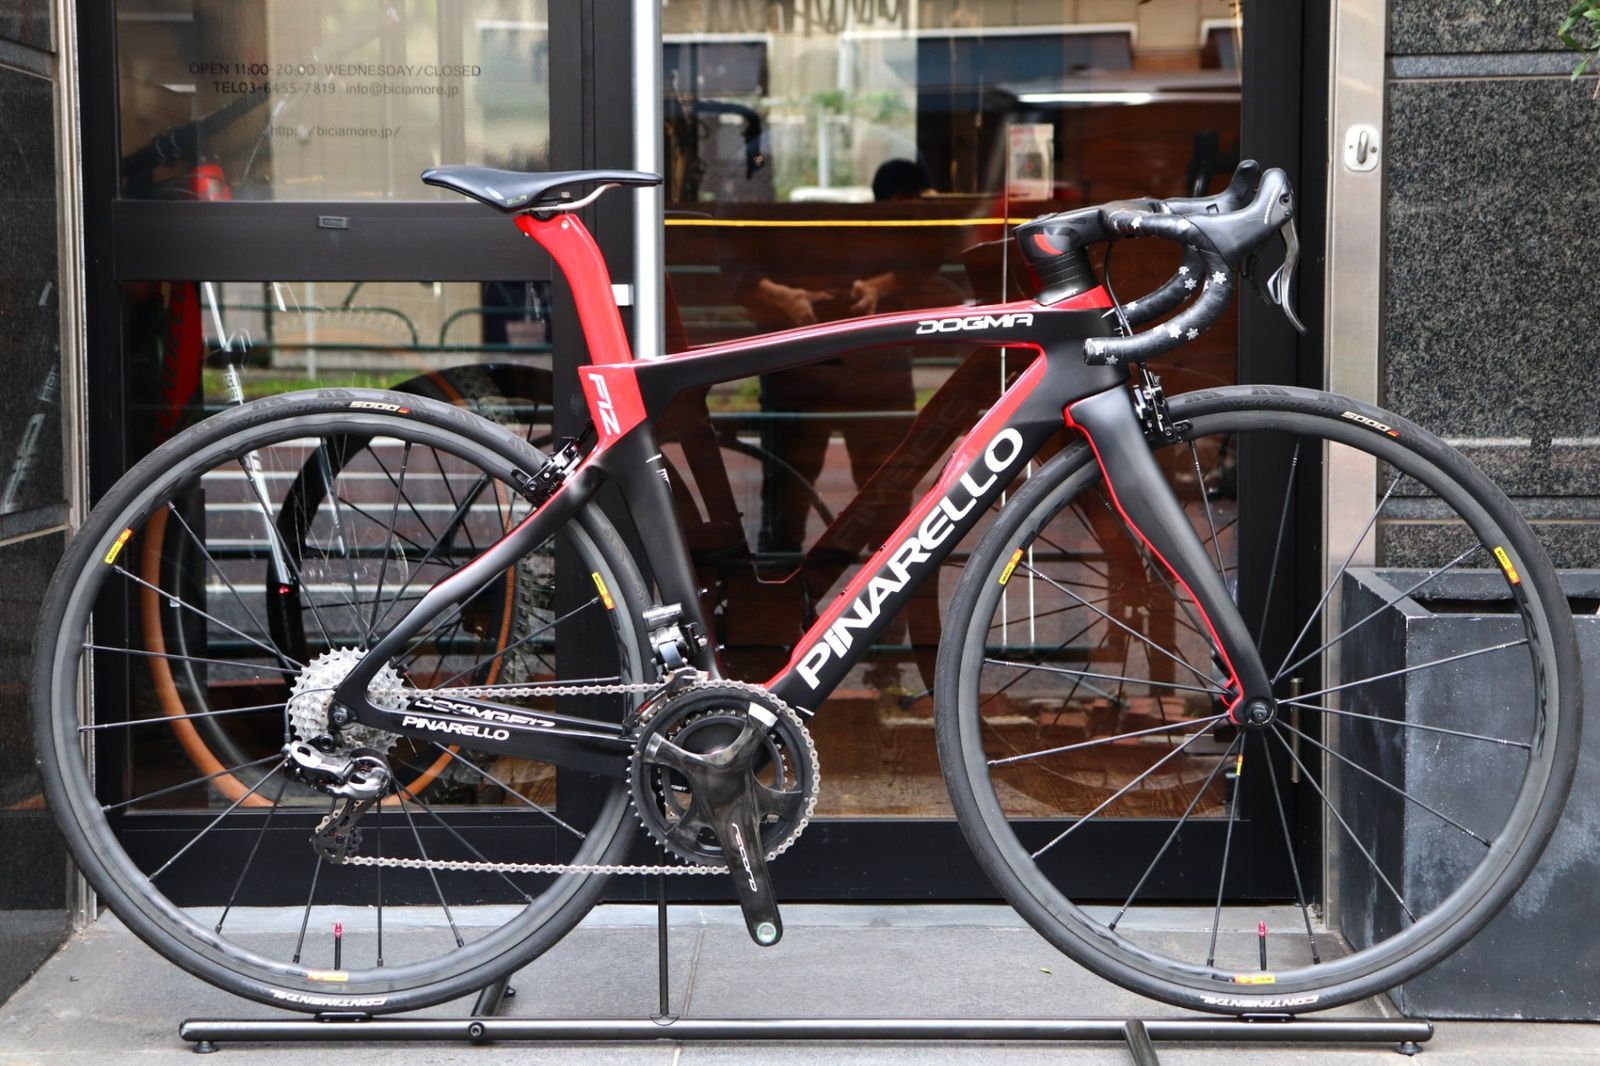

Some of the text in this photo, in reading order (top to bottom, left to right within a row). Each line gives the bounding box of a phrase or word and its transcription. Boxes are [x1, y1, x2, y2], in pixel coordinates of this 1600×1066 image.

[189, 63, 229, 76] OPEN
[214, 81, 459, 97] TEL03-6455-7819 info@biciamore.jp
[270, 125, 401, 139] http:/biciamore.jp/
[916, 313, 1033, 334] DOGMA
[349, 401, 400, 411] 5000
[1341, 411, 1392, 432] 5000
[796, 428, 1023, 690] PINARELLO
[402, 715, 510, 741] PINARELLO
